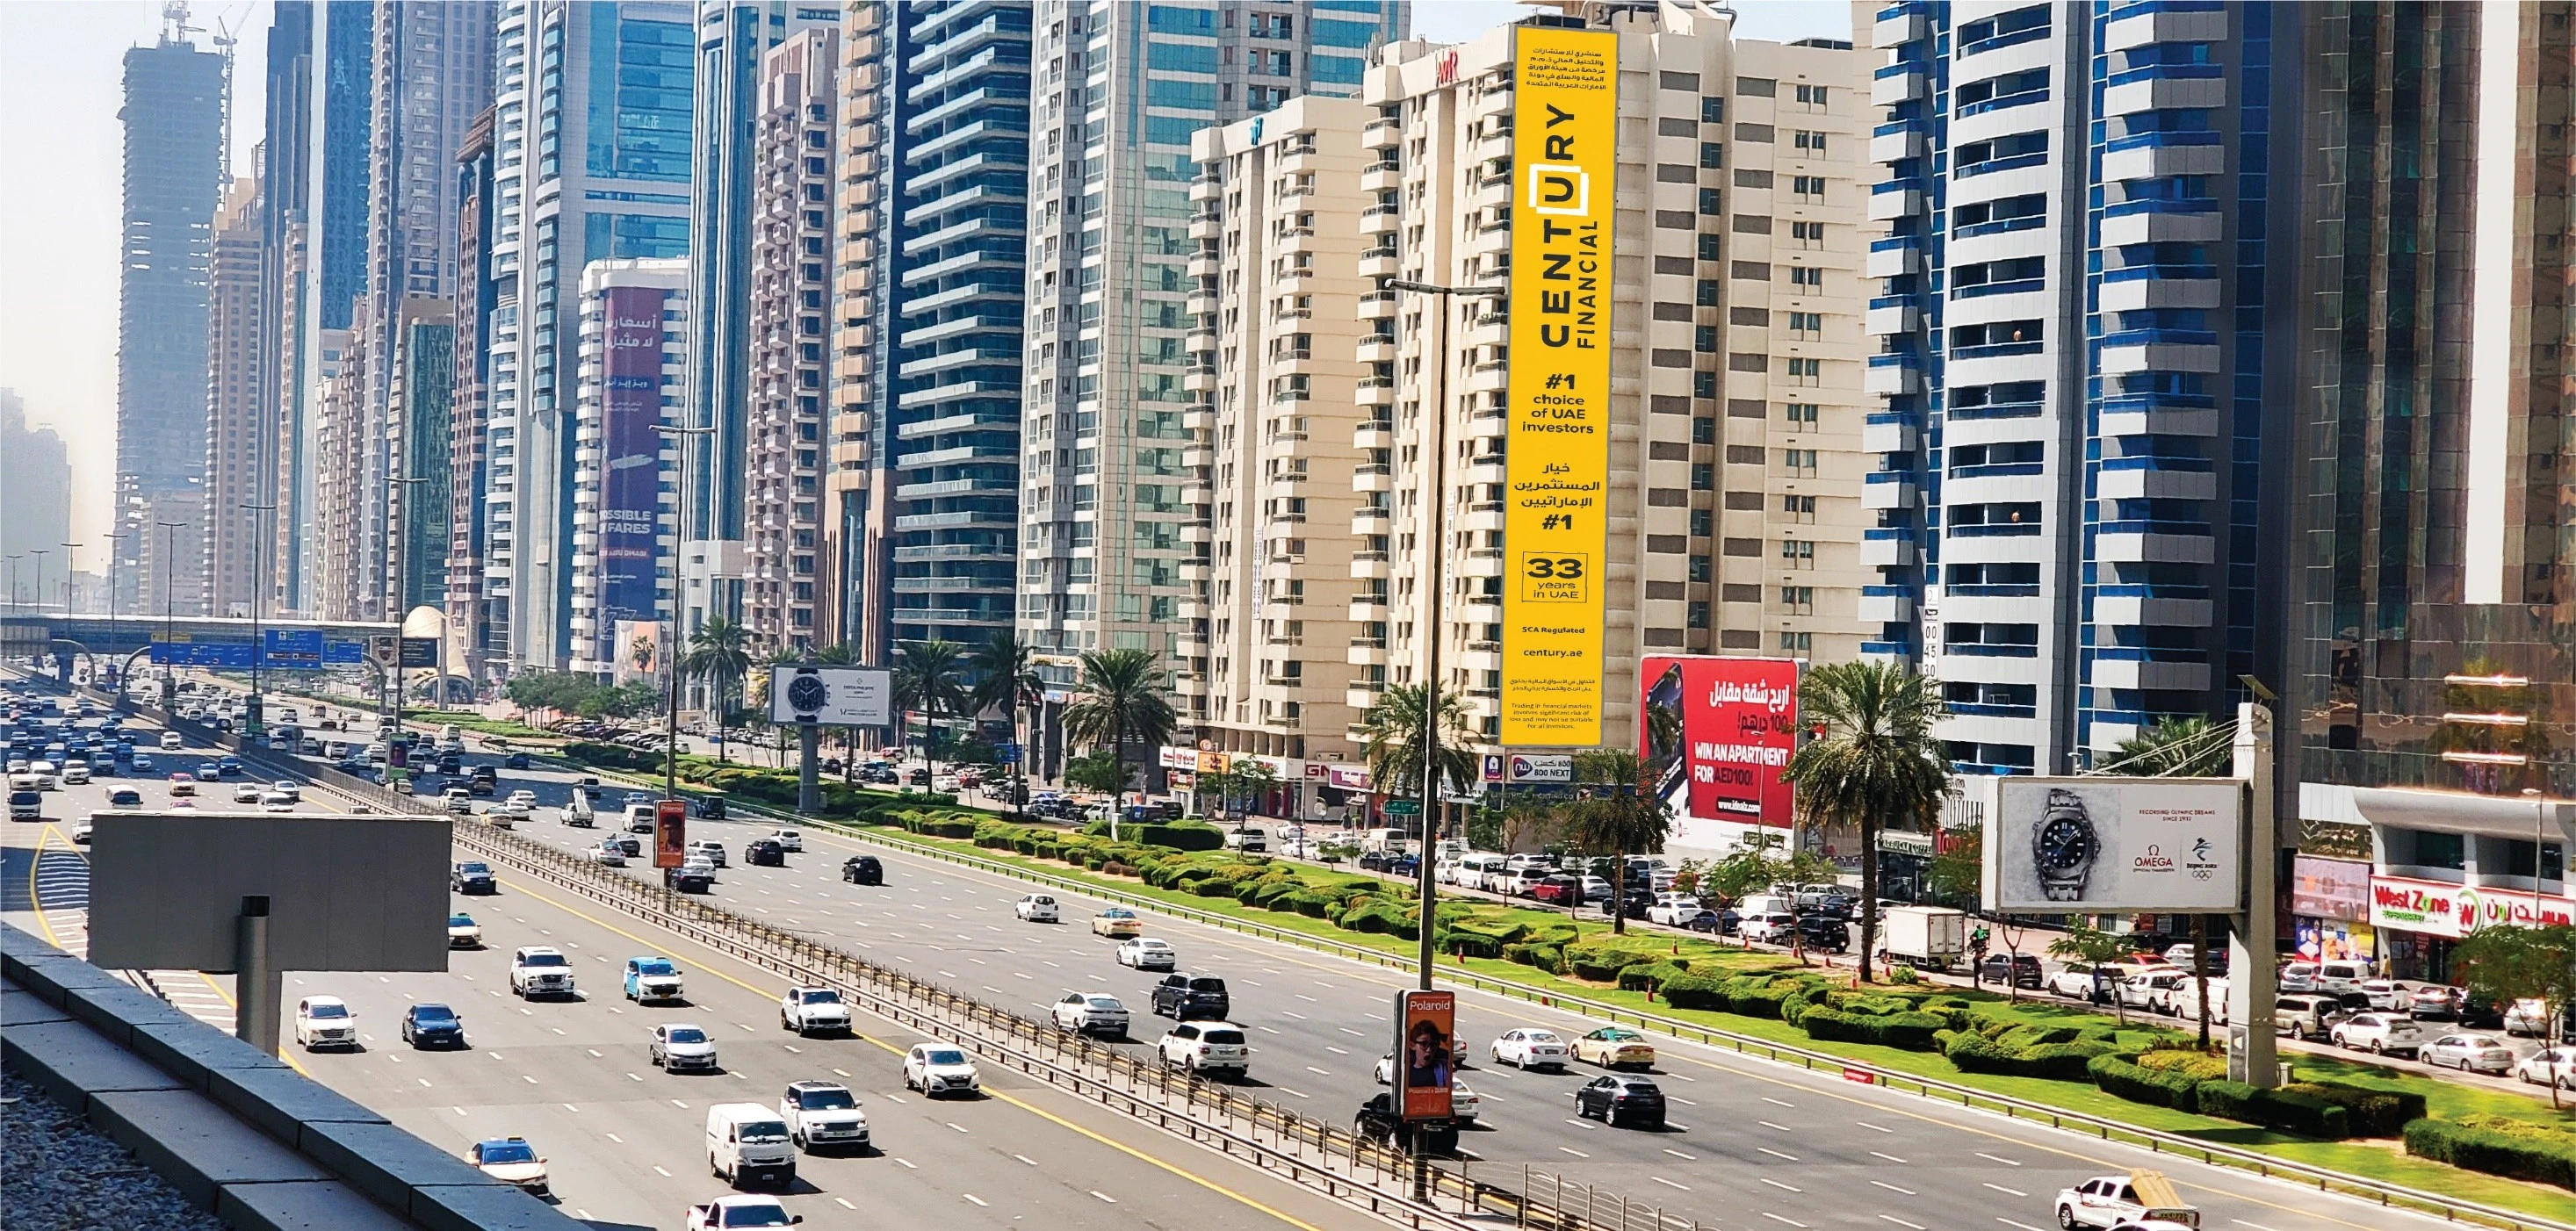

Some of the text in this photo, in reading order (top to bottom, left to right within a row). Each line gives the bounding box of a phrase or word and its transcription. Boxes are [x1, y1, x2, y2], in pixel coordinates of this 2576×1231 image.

[1541, 103, 1575, 348] CENTURY
[1577, 220, 1598, 349] FINANCIAL
[1546, 374, 1575, 389] #1
[1533, 394, 1584, 406] choice
[1531, 408, 1585, 419] of UAE
[1522, 421, 1593, 434] investors
[1542, 463, 1570, 474] خيار
[1514, 479, 1600, 492] المستثمرين
[608, 522, 651, 534] FARES
[1542, 515, 1572, 530] #1
[1527, 558, 1583, 579] 33
[1523, 649, 1583, 659] century.ae
[1709, 680, 1741, 709] مقابل
[1743, 679, 1768, 705] شقة
[1694, 742, 1788, 767] WIN AN APARTMENT
[1694, 765, 1714, 783] FOR
[2134, 857, 2173, 867] OMEGA
[2374, 884, 2450, 914] West Zone
[1410, 1000, 1450, 1011] Polaroid
